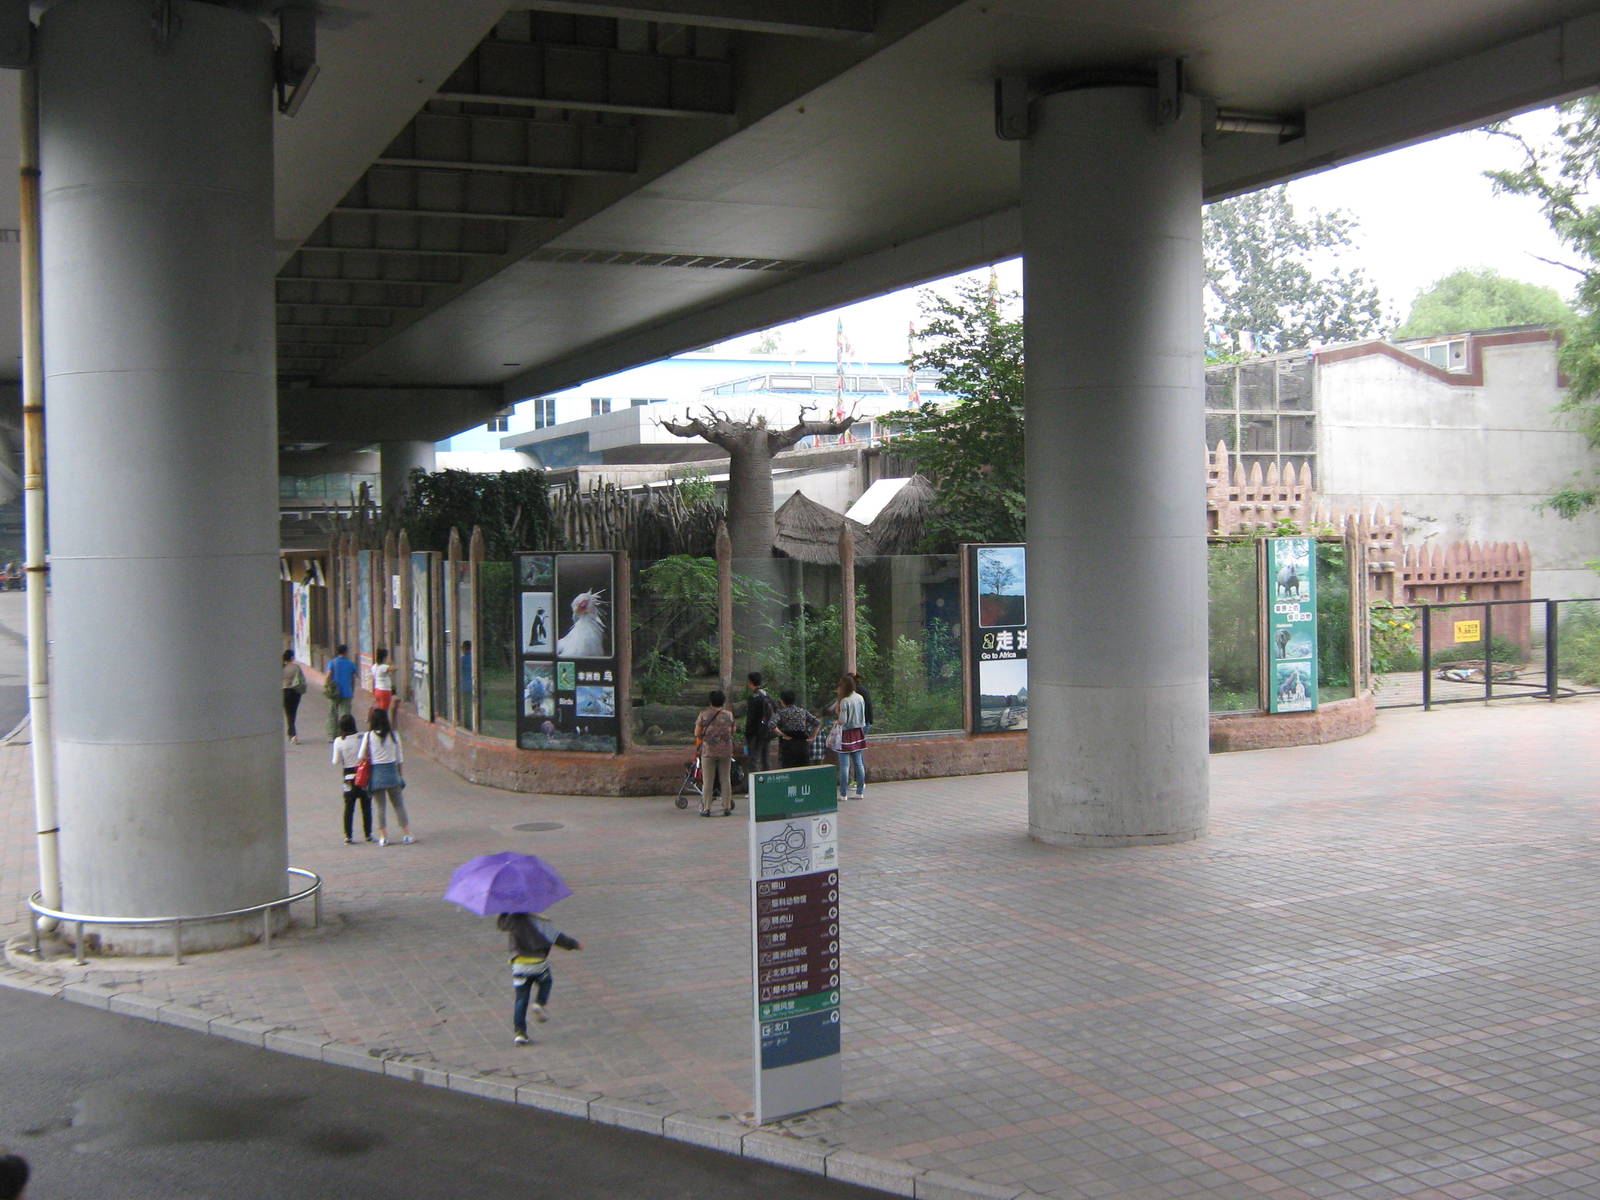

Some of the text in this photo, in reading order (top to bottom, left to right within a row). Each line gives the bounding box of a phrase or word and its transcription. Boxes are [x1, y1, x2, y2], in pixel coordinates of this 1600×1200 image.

[577, 670, 613, 681] 非洲的鸟
[774, 1021, 789, 1031] 北门
